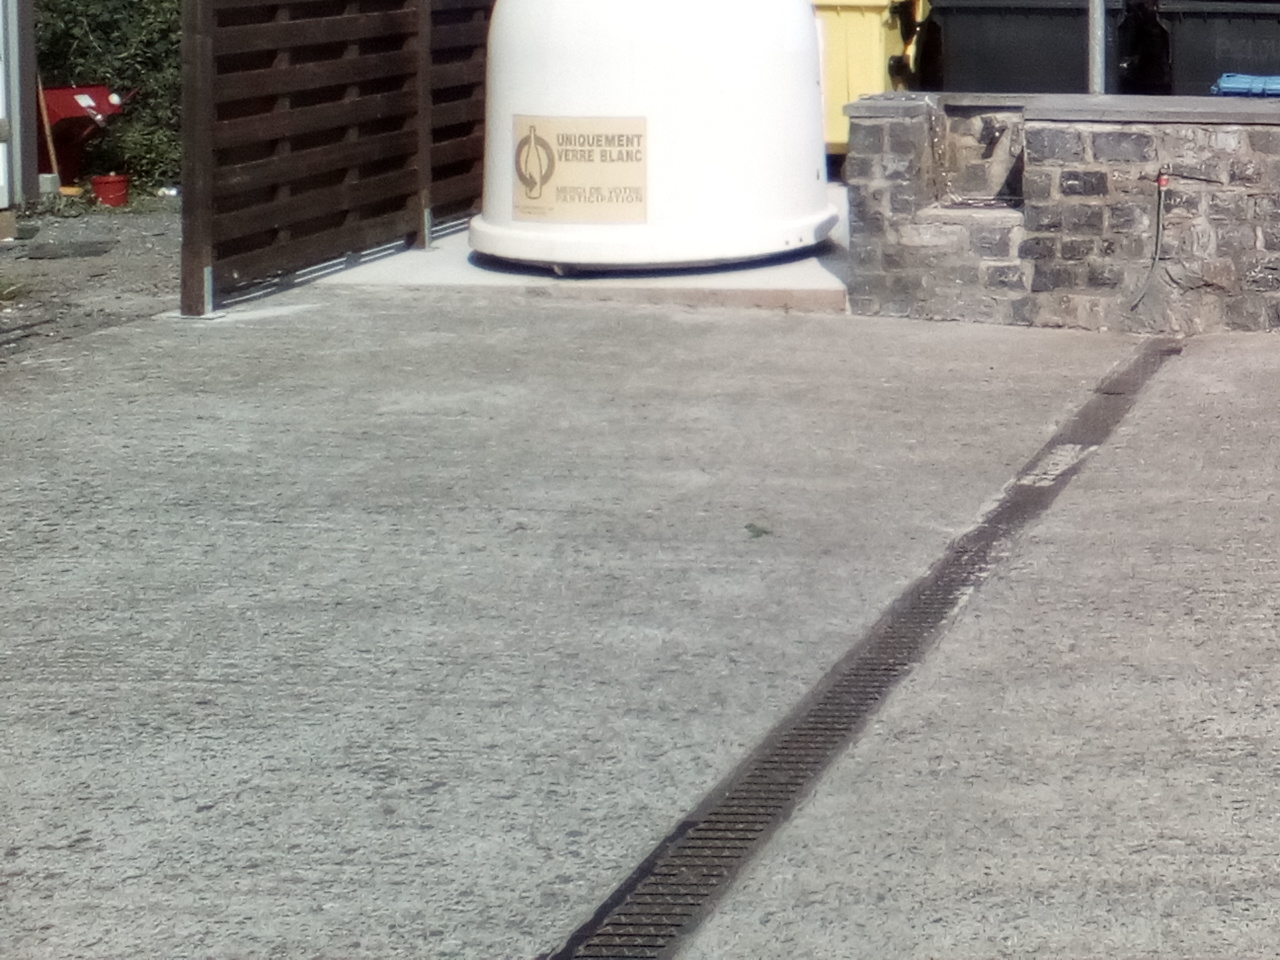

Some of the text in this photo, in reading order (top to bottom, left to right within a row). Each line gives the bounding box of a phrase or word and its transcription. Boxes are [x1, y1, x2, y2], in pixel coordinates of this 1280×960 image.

[557, 133, 643, 147] UNIQUEMENT
[557, 149, 643, 162] VERRE BLANC
[556, 194, 643, 203] PARTICIPATION
